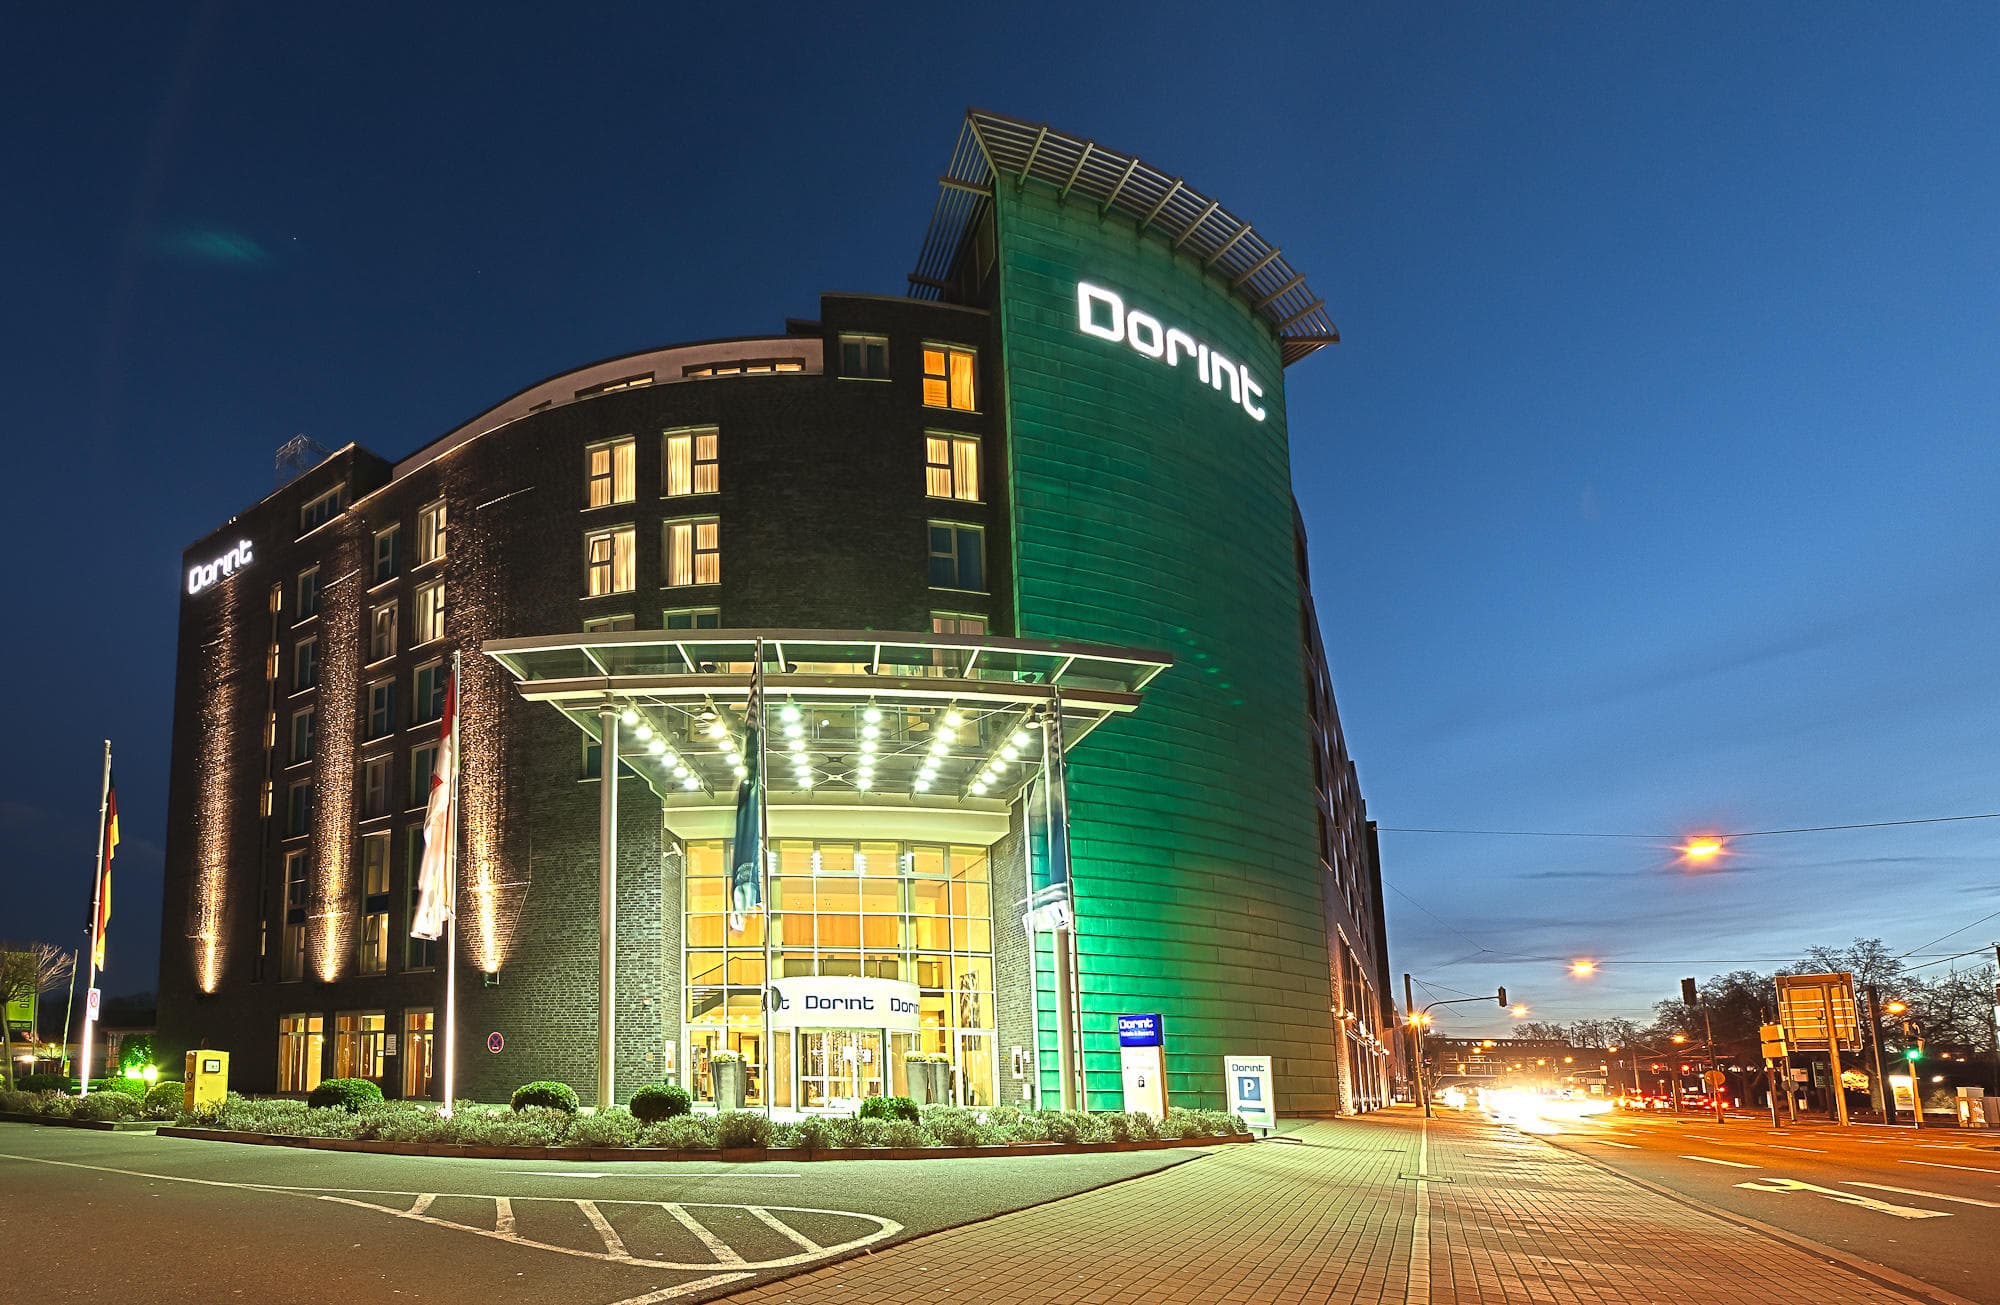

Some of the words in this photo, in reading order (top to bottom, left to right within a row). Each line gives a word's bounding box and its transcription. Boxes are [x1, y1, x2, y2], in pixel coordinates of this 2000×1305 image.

[1077, 281, 1266, 422] Dorint
[188, 539, 253, 595] Dorint
[805, 995, 874, 1010] Dorint
[890, 998, 920, 1014] Dorin
[1119, 1018, 1153, 1029] Dorint
[1231, 1063, 1265, 1072] Dorint
[1243, 1079, 1255, 1098] P
